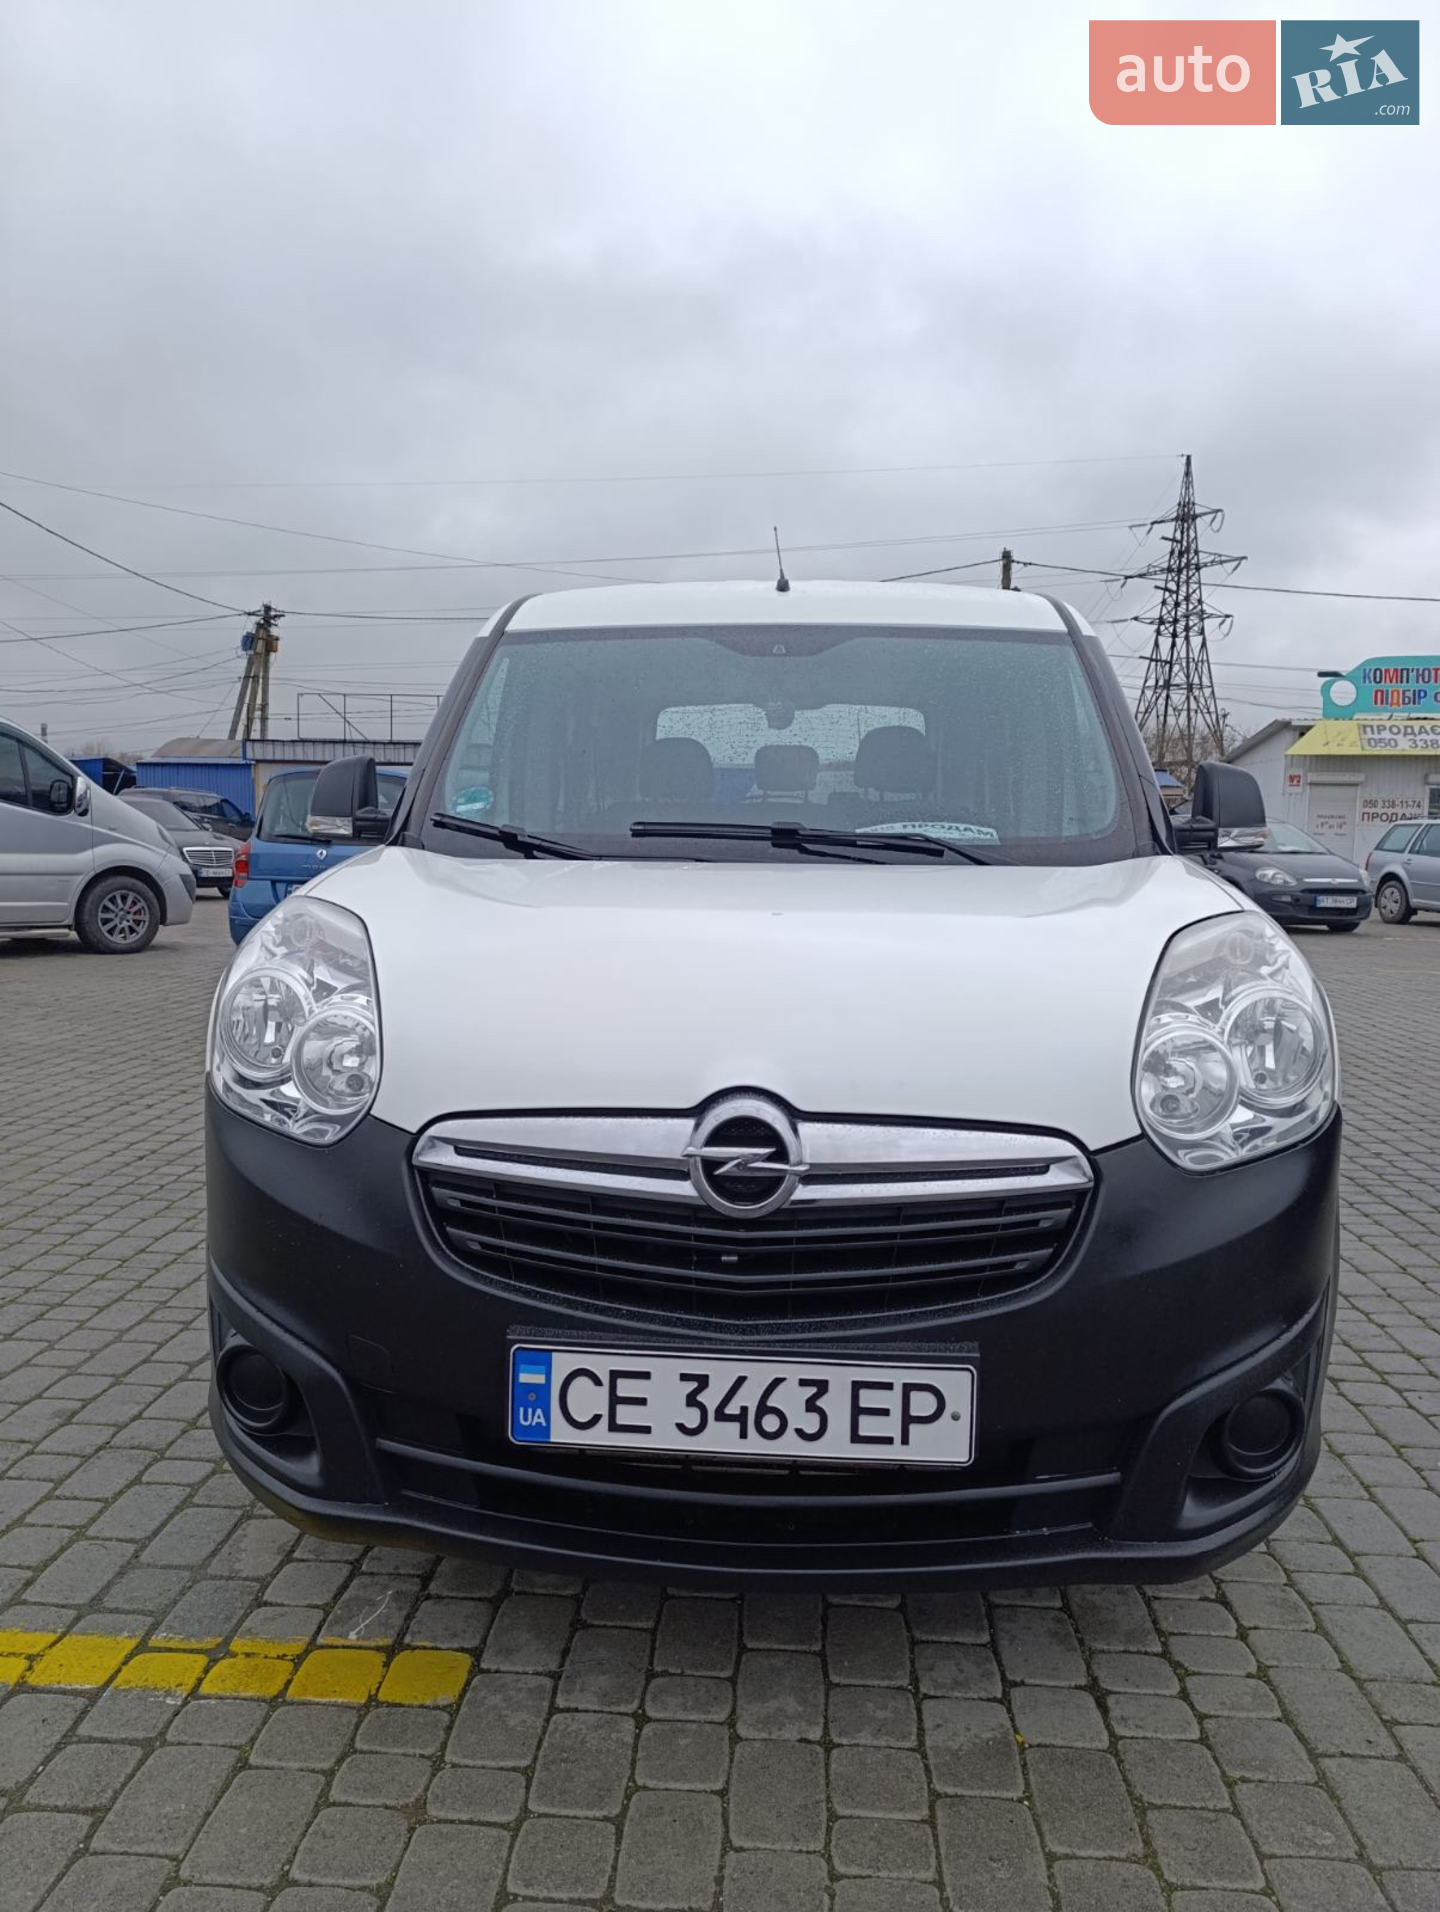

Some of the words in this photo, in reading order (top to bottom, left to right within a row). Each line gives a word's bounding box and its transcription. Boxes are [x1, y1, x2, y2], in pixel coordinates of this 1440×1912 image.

[1373, 688, 1428, 708] ПІДБІР
[1367, 737, 1399, 749] 050
[1363, 799, 1379, 809] 050
[1381, 799, 1422, 809] 338-11-74
[558, 1366, 653, 1435] CE
[674, 1372, 830, 1443] 3463
[849, 1379, 947, 1446] EP
[518, 1407, 547, 1427] UA
